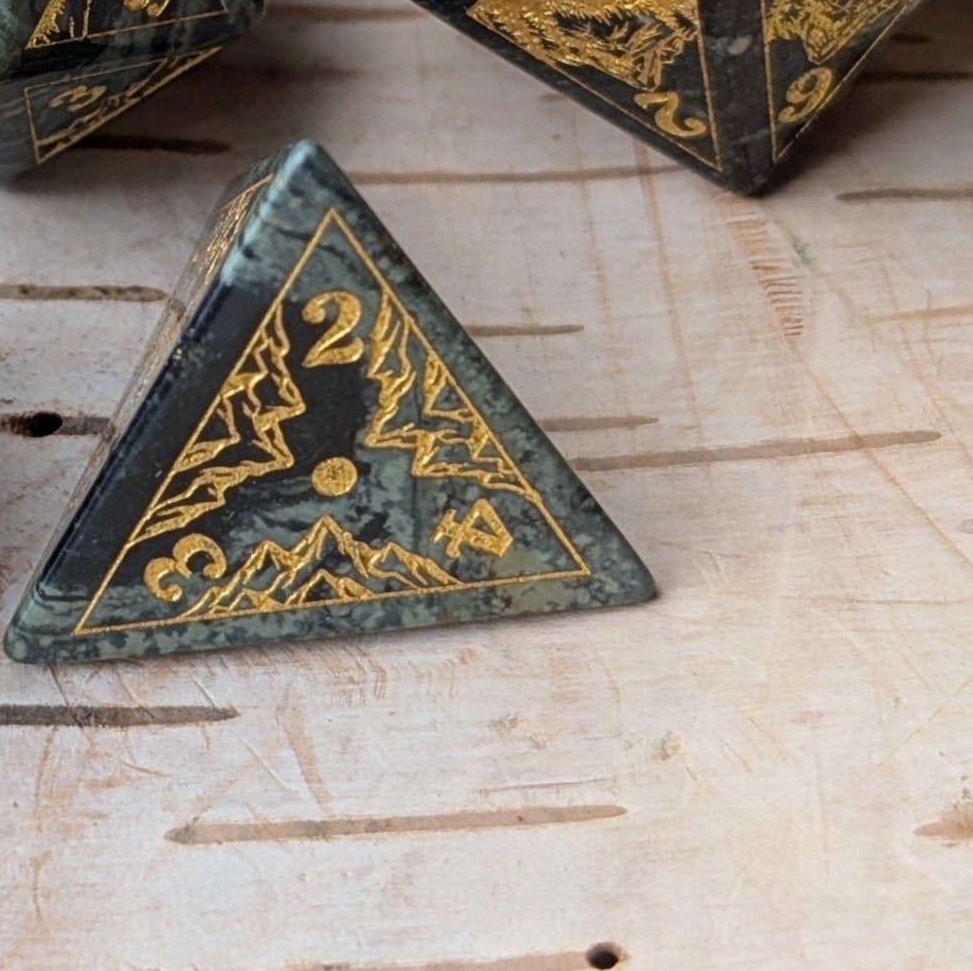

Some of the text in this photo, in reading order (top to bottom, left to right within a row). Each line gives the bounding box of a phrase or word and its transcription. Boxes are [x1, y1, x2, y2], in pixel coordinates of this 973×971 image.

[49, 84, 107, 112] 3
[633, 91, 707, 137] 2
[301, 291, 364, 367] 2
[433, 498, 514, 558] 4
[143, 532, 226, 602] 3
